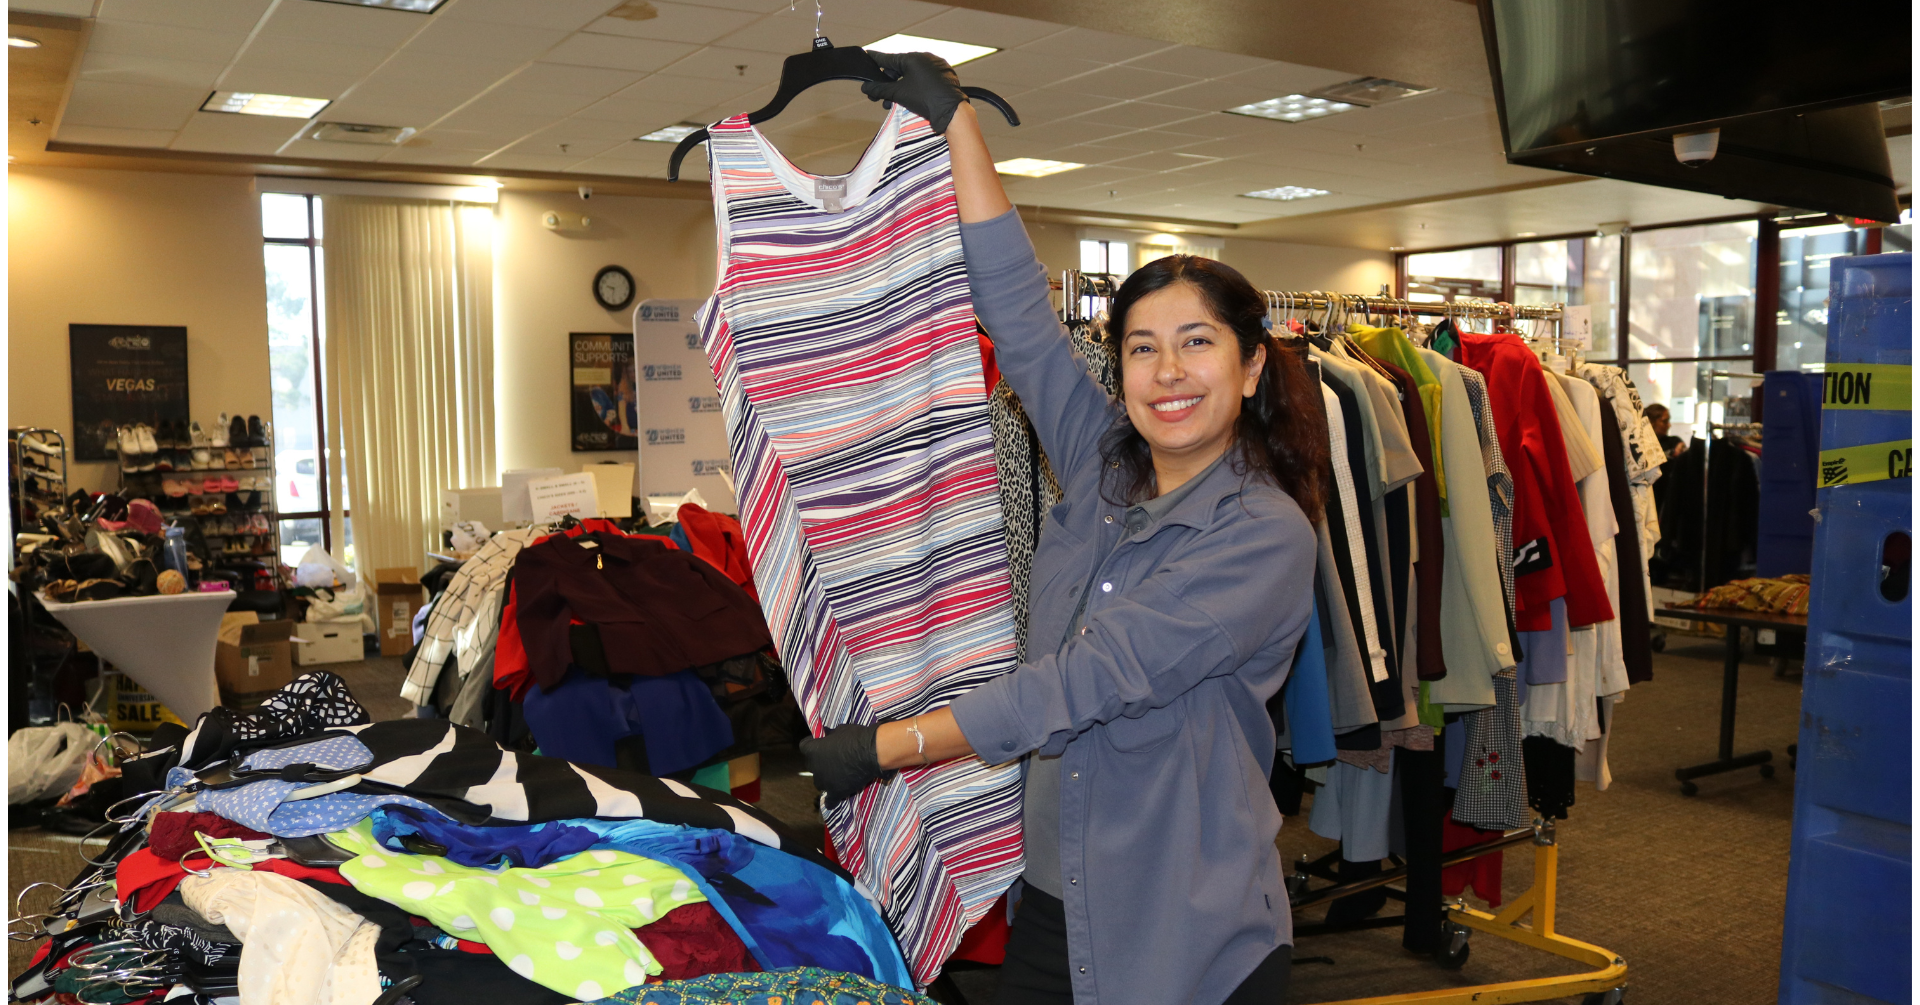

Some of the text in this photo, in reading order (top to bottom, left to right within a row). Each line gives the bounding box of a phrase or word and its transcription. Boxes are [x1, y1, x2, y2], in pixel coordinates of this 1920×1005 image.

[574, 340, 634, 352] COMMUNITY
[575, 352, 628, 362] SUPPORTS
[106, 378, 155, 391] VEGAS
[117, 704, 162, 722] SALE
